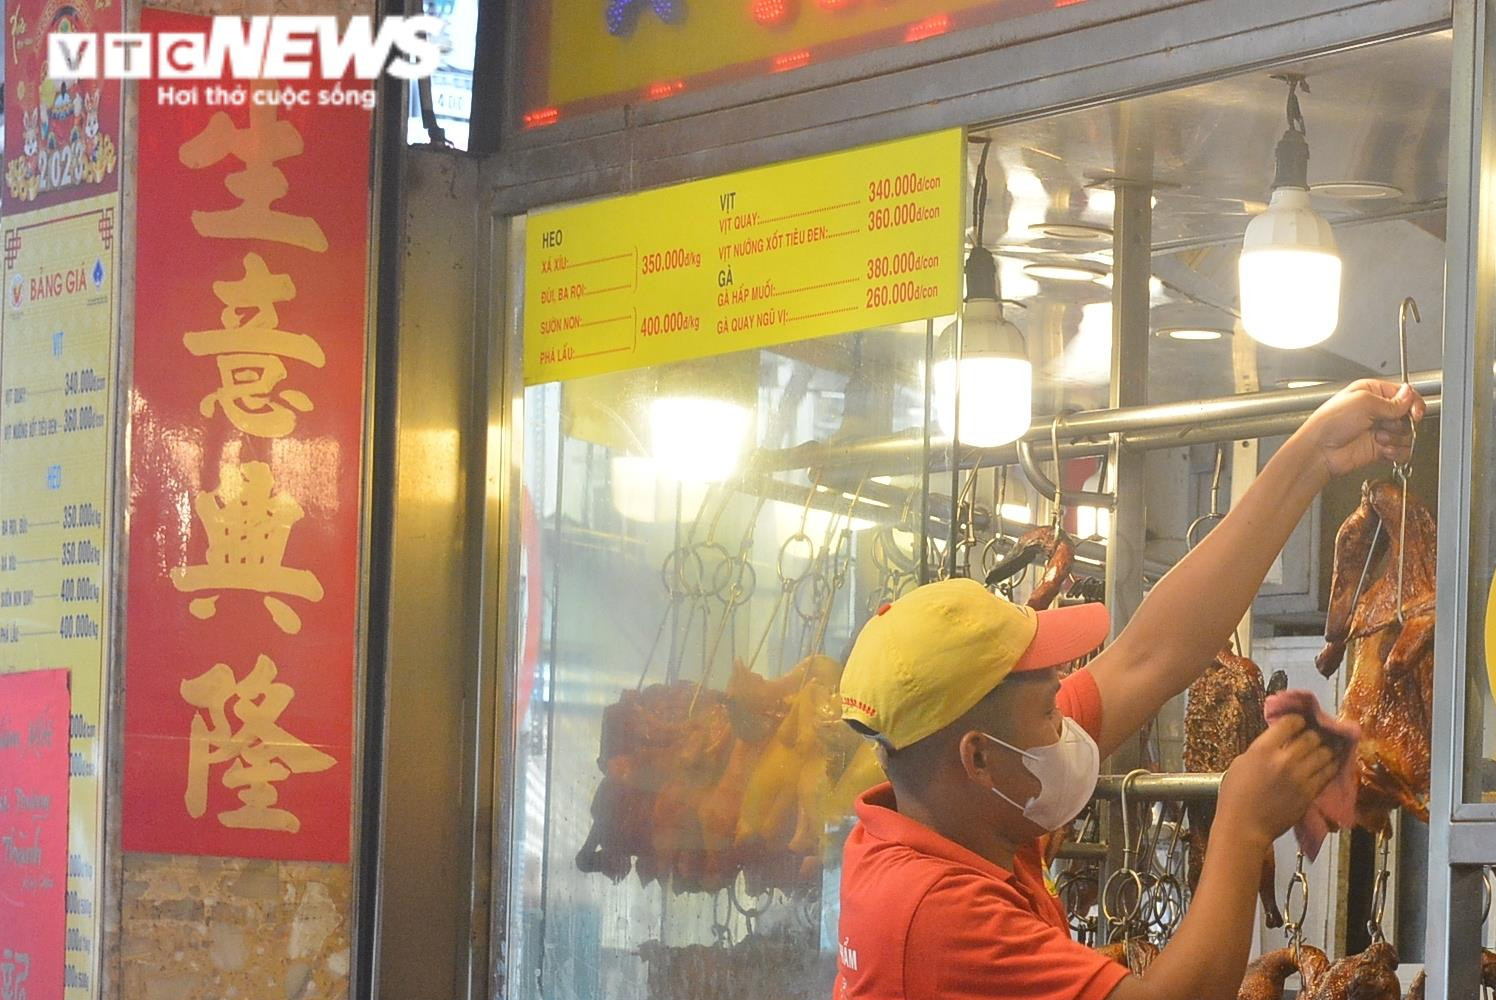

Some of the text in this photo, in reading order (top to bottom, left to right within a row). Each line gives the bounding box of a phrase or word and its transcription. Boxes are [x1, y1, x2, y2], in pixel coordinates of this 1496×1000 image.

[38, 141, 84, 192] 2023
[719, 218, 732, 235] VỊT
[868, 173, 941, 202] 340.000đ/con
[720, 192, 736, 214] VỊT
[542, 229, 563, 249] HEO
[718, 245, 732, 262] VỊT
[766, 229, 783, 251] XỐT
[868, 202, 940, 231] 360.000đ/con
[642, 248, 701, 275] 350.000đ/kg
[30, 262, 87, 301] BẢNG GIÁ
[717, 289, 729, 307] GÀ
[867, 251, 939, 280] 380.000đ/con
[718, 264, 733, 287] GÀ
[558, 287, 569, 301] BA
[716, 316, 729, 335] GÀ
[731, 314, 754, 332] QUAY
[866, 281, 938, 308] 260.000đ/con
[641, 312, 700, 337] 400.000đ/kg
[539, 350, 555, 365] PHÁ
